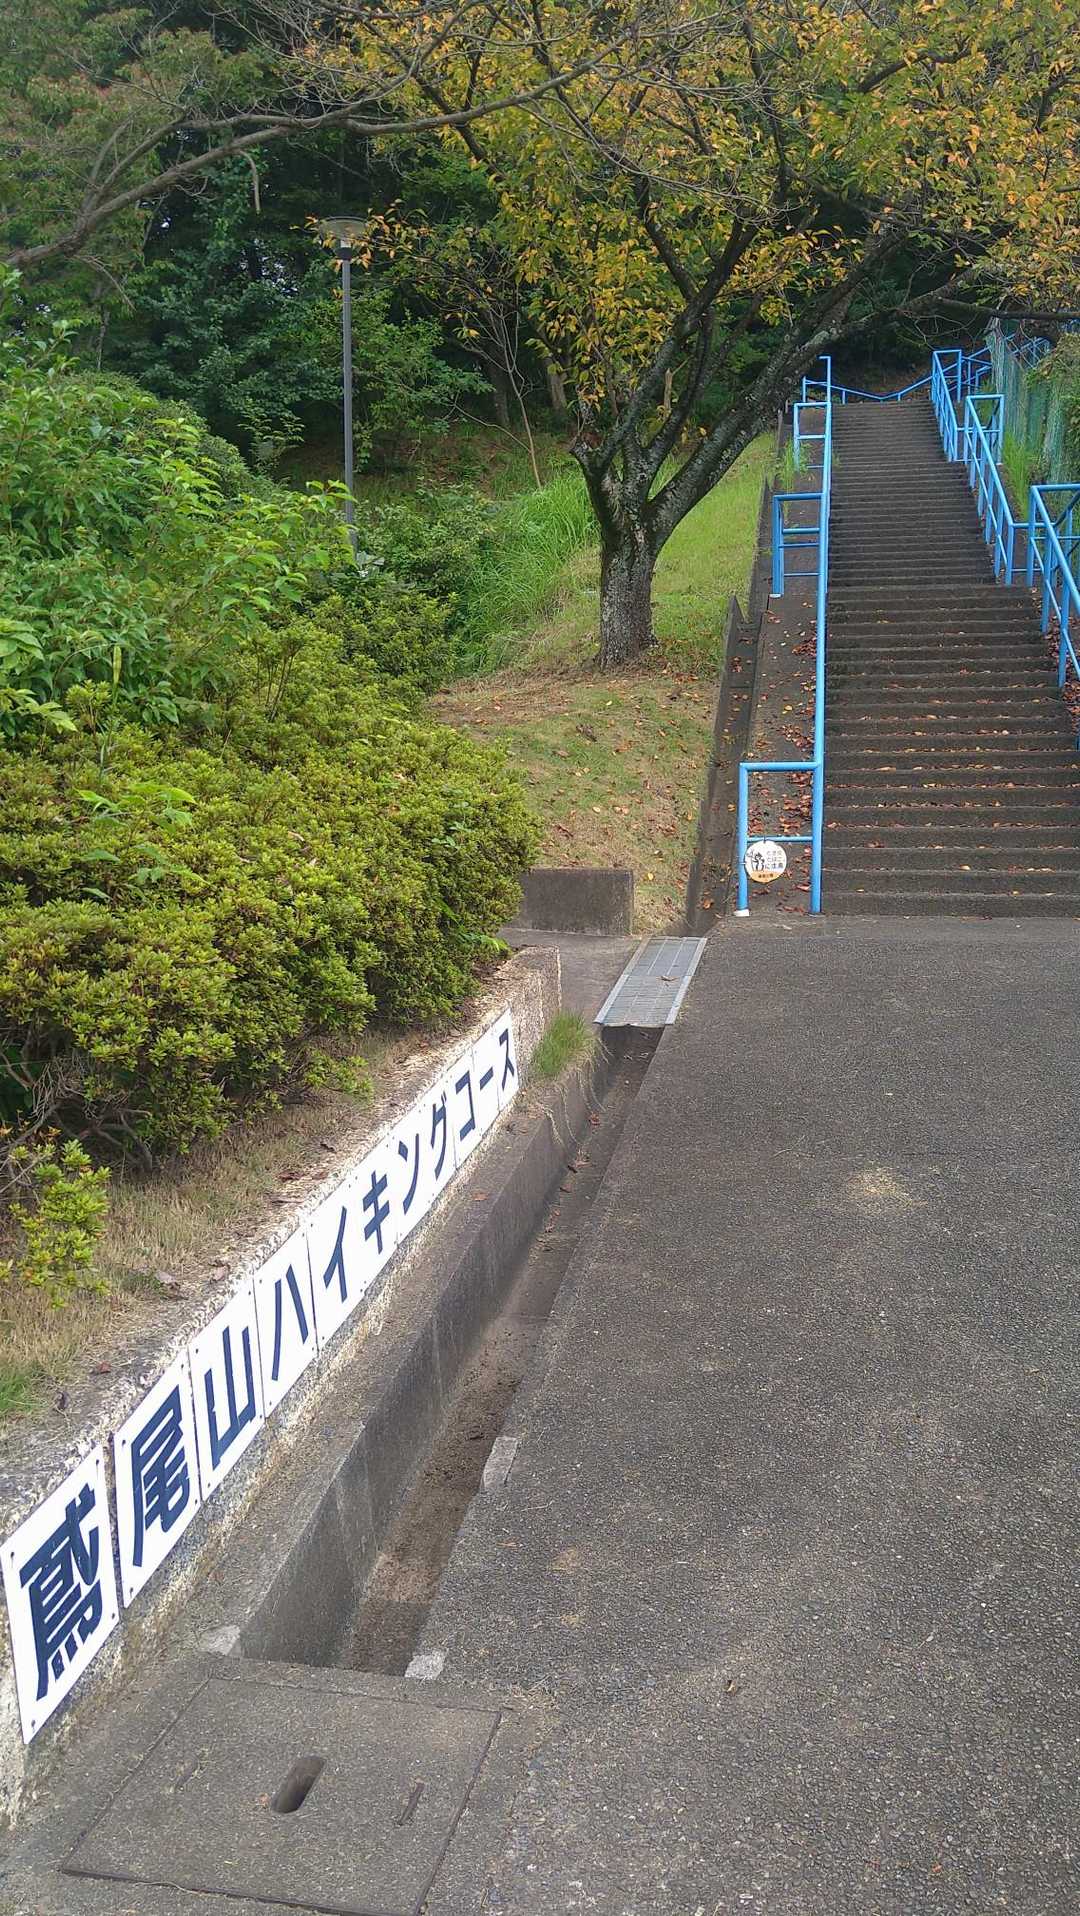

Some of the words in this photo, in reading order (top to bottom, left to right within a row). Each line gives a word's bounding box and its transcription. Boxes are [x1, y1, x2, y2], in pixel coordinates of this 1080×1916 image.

[19, 1030, 517, 1702] 鳶尾山ハイキングコース
